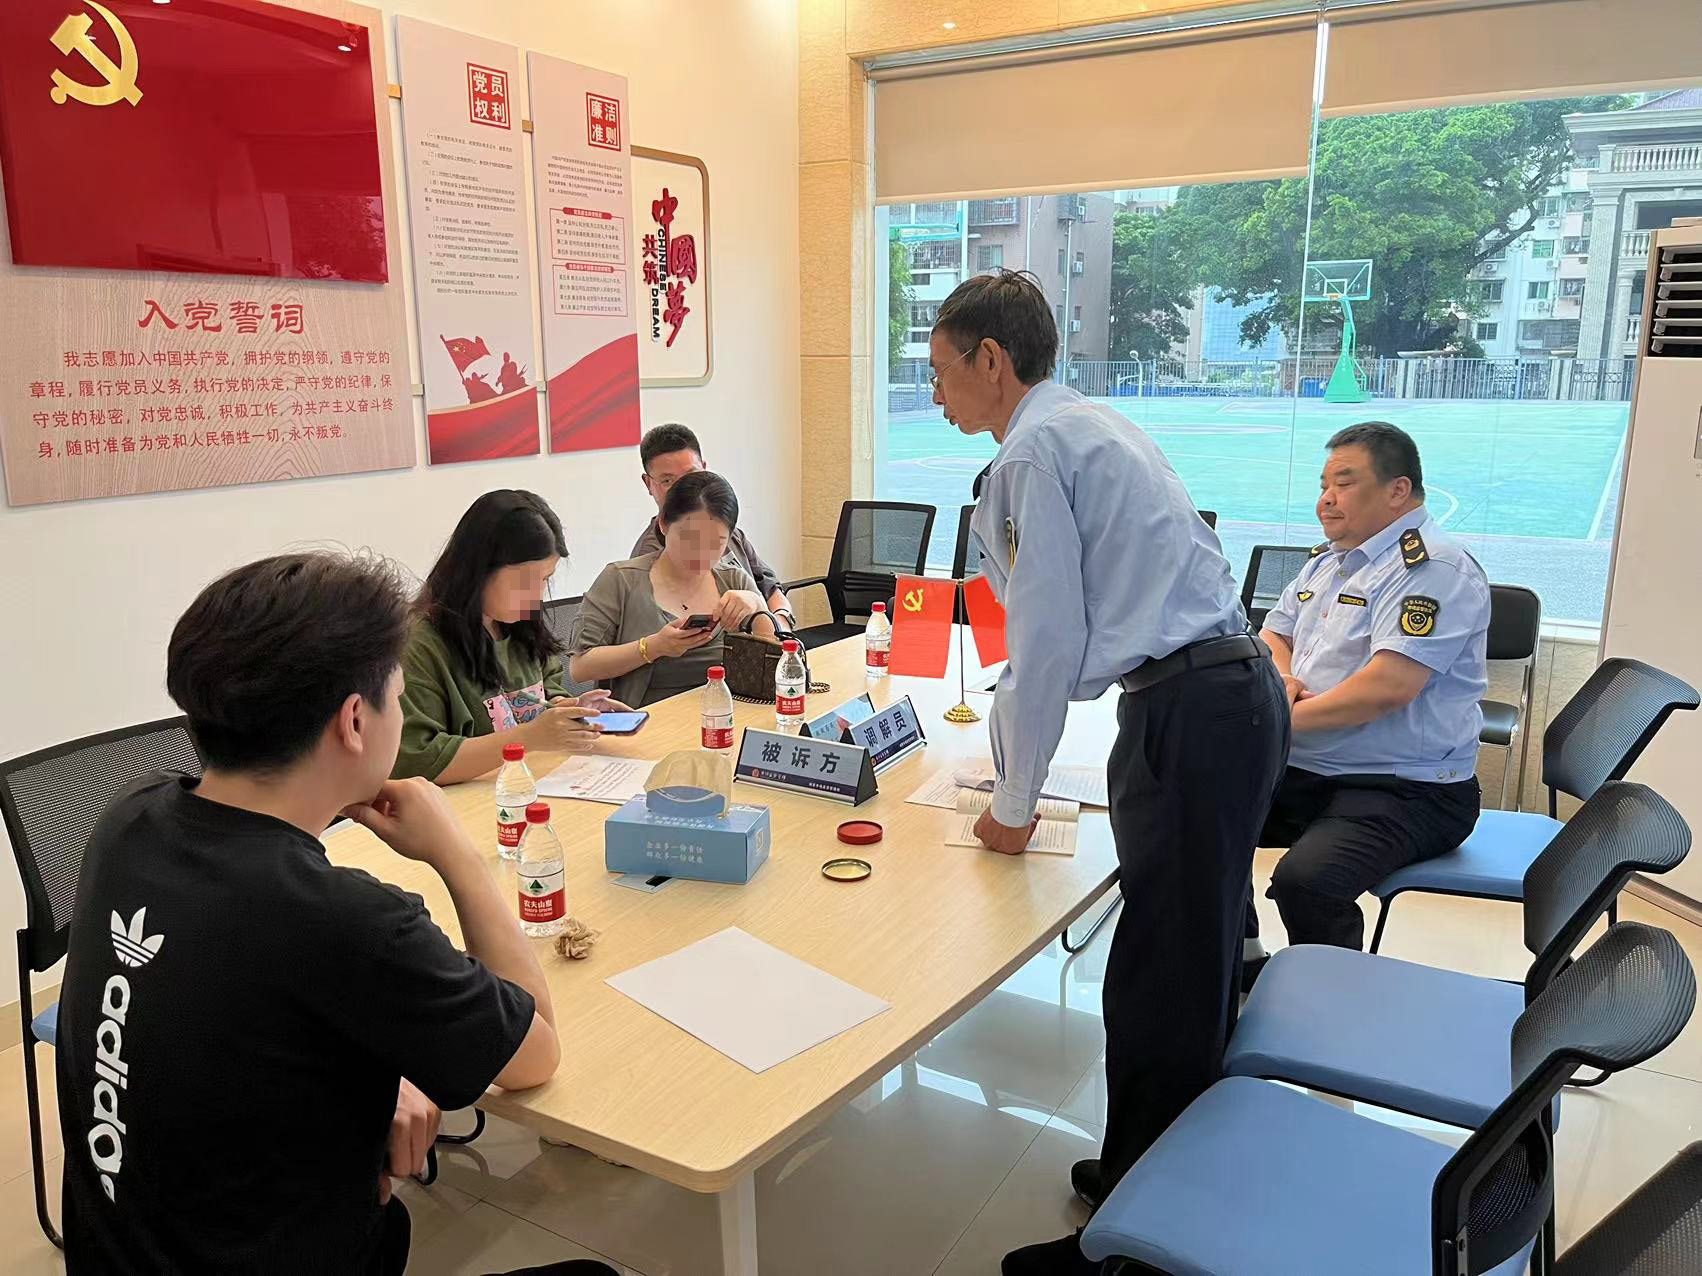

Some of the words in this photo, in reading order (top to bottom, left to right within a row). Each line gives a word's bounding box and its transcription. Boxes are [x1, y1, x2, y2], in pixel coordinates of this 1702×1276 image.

[474, 72, 504, 97] 党员
[475, 98, 506, 122] 权利
[592, 101, 616, 122] 廉洁
[592, 124, 617, 145] 准则
[658, 228, 668, 292] CHINESE
[138, 300, 304, 334] 入党誓词
[651, 288, 661, 338] DREAM
[64, 350, 391, 368] 我志愿加入中国共产党，拥护党的纲领，遵守党的
[864, 711, 907, 748] 调解员
[762, 741, 840, 774] 被诉方
[524, 899, 553, 909] 农夫山泉
